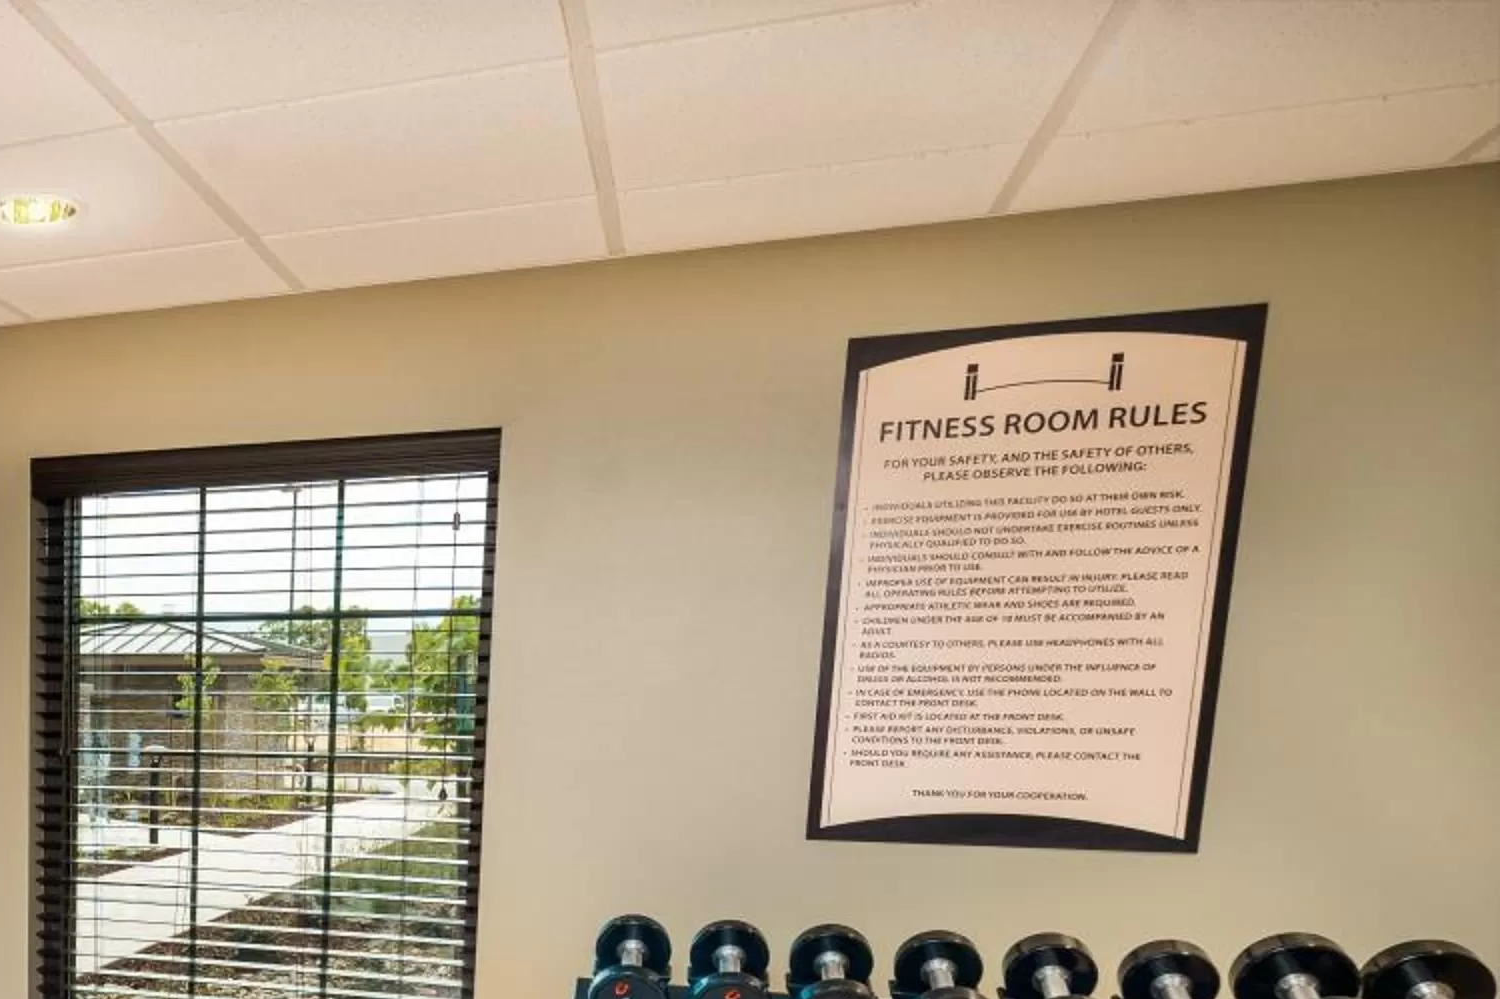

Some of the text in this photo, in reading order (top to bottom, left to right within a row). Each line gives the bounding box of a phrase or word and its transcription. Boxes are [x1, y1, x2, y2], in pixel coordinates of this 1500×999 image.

[878, 400, 1208, 442] FITNESS ROOM RULES
[883, 442, 1194, 469] FOR YOUR SAFETY, AND THE SAFETY OF OTHERS,
[922, 460, 1147, 482] PLEASE OBSERVE THE FOLLOWING:
